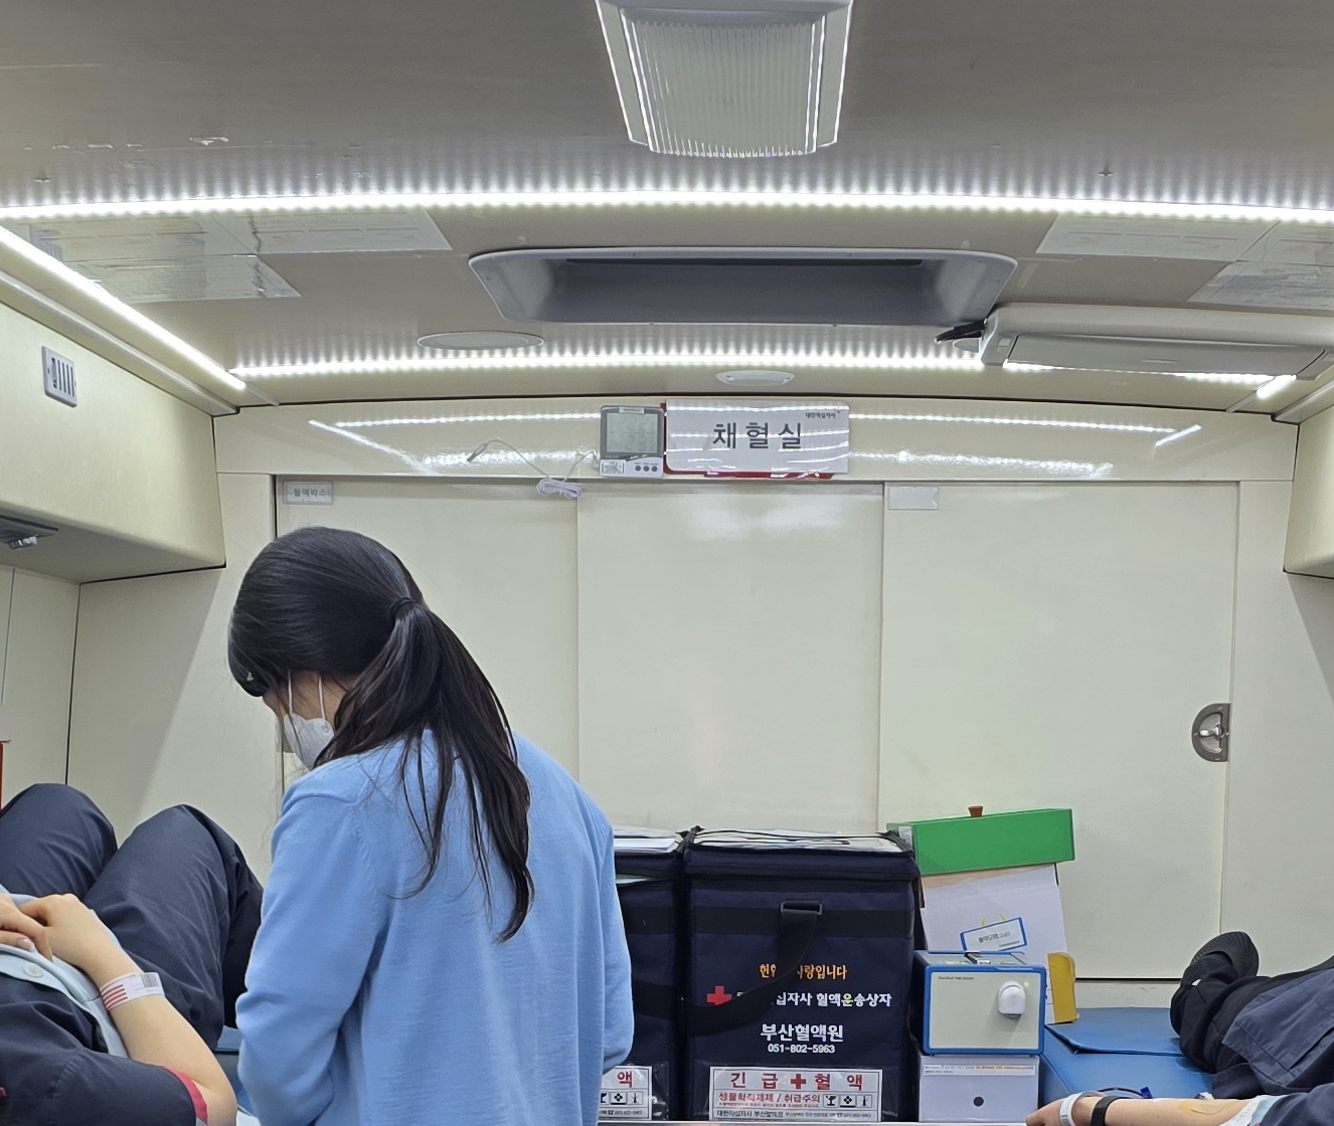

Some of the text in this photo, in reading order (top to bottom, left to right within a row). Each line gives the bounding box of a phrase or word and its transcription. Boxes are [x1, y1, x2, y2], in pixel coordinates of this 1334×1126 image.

[713, 421, 802, 449] 채혈실
[816, 992, 892, 1008] 혈액운송상자
[760, 1023, 844, 1043] 부산혈액원
[767, 1043, 836, 1054] 051-802-5963
[784, 1093, 820, 1104] 취급주의
